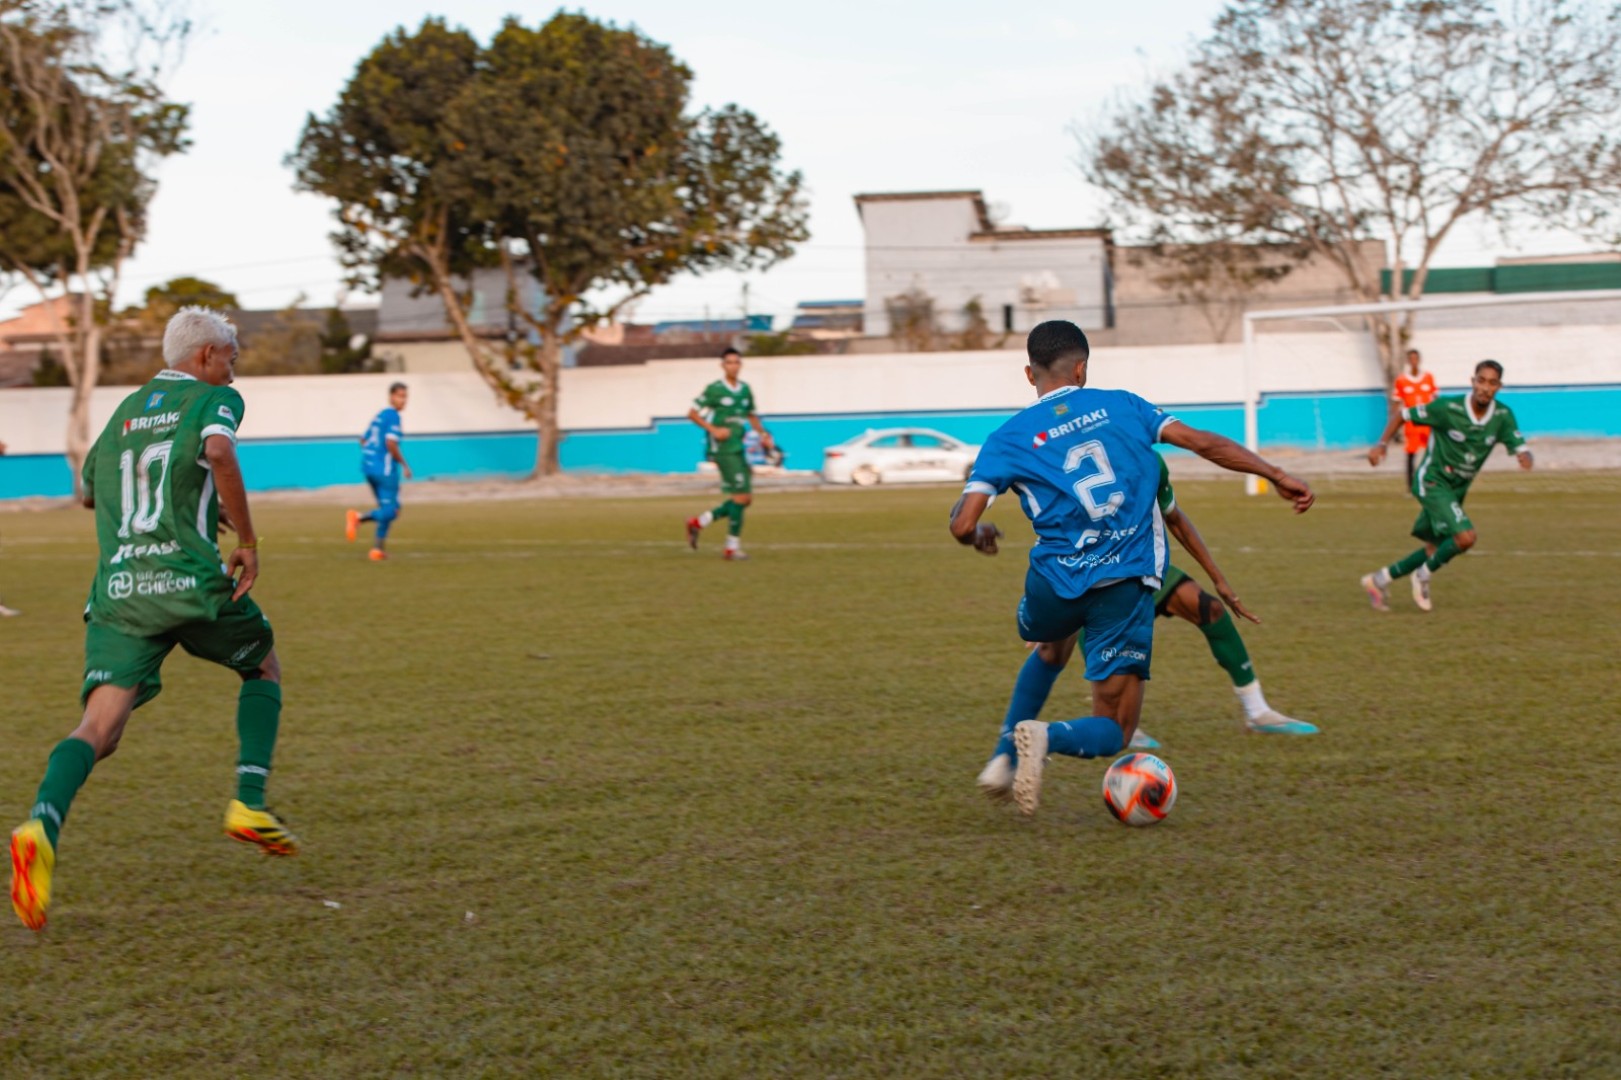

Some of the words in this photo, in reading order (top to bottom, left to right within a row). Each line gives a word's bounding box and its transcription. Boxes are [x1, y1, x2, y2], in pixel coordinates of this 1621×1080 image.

[1048, 408, 1108, 438] BRITAKI
[118, 440, 174, 539] 10
[1062, 439, 1126, 522] 2
[137, 576, 197, 596] CHECON
